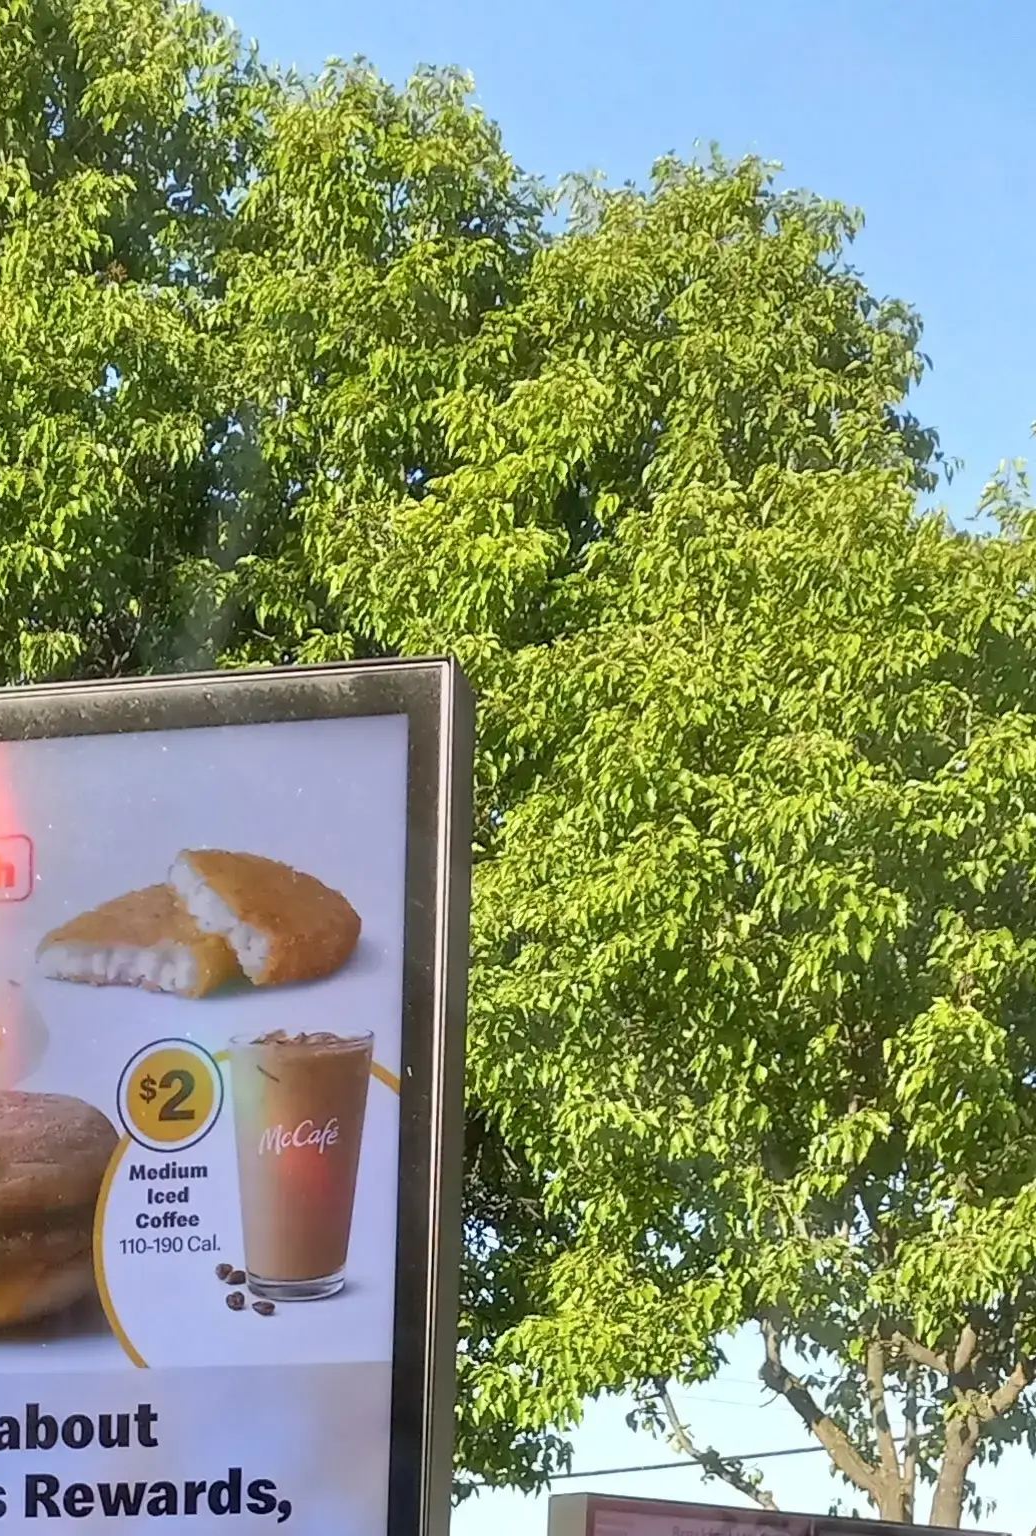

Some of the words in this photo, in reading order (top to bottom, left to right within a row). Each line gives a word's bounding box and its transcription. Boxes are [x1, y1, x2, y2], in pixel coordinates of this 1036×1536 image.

[139, 1069, 195, 1122] $2
[258, 1117, 340, 1155] McCafé
[129, 1162, 208, 1181] Medium
[147, 1187, 189, 1204] Iced
[136, 1212, 200, 1229] Coffee
[120, 1238, 183, 1254] 110-190
[187, 1235, 221, 1252] Cal.
[24, 1467, 292, 1523] Rewards,
